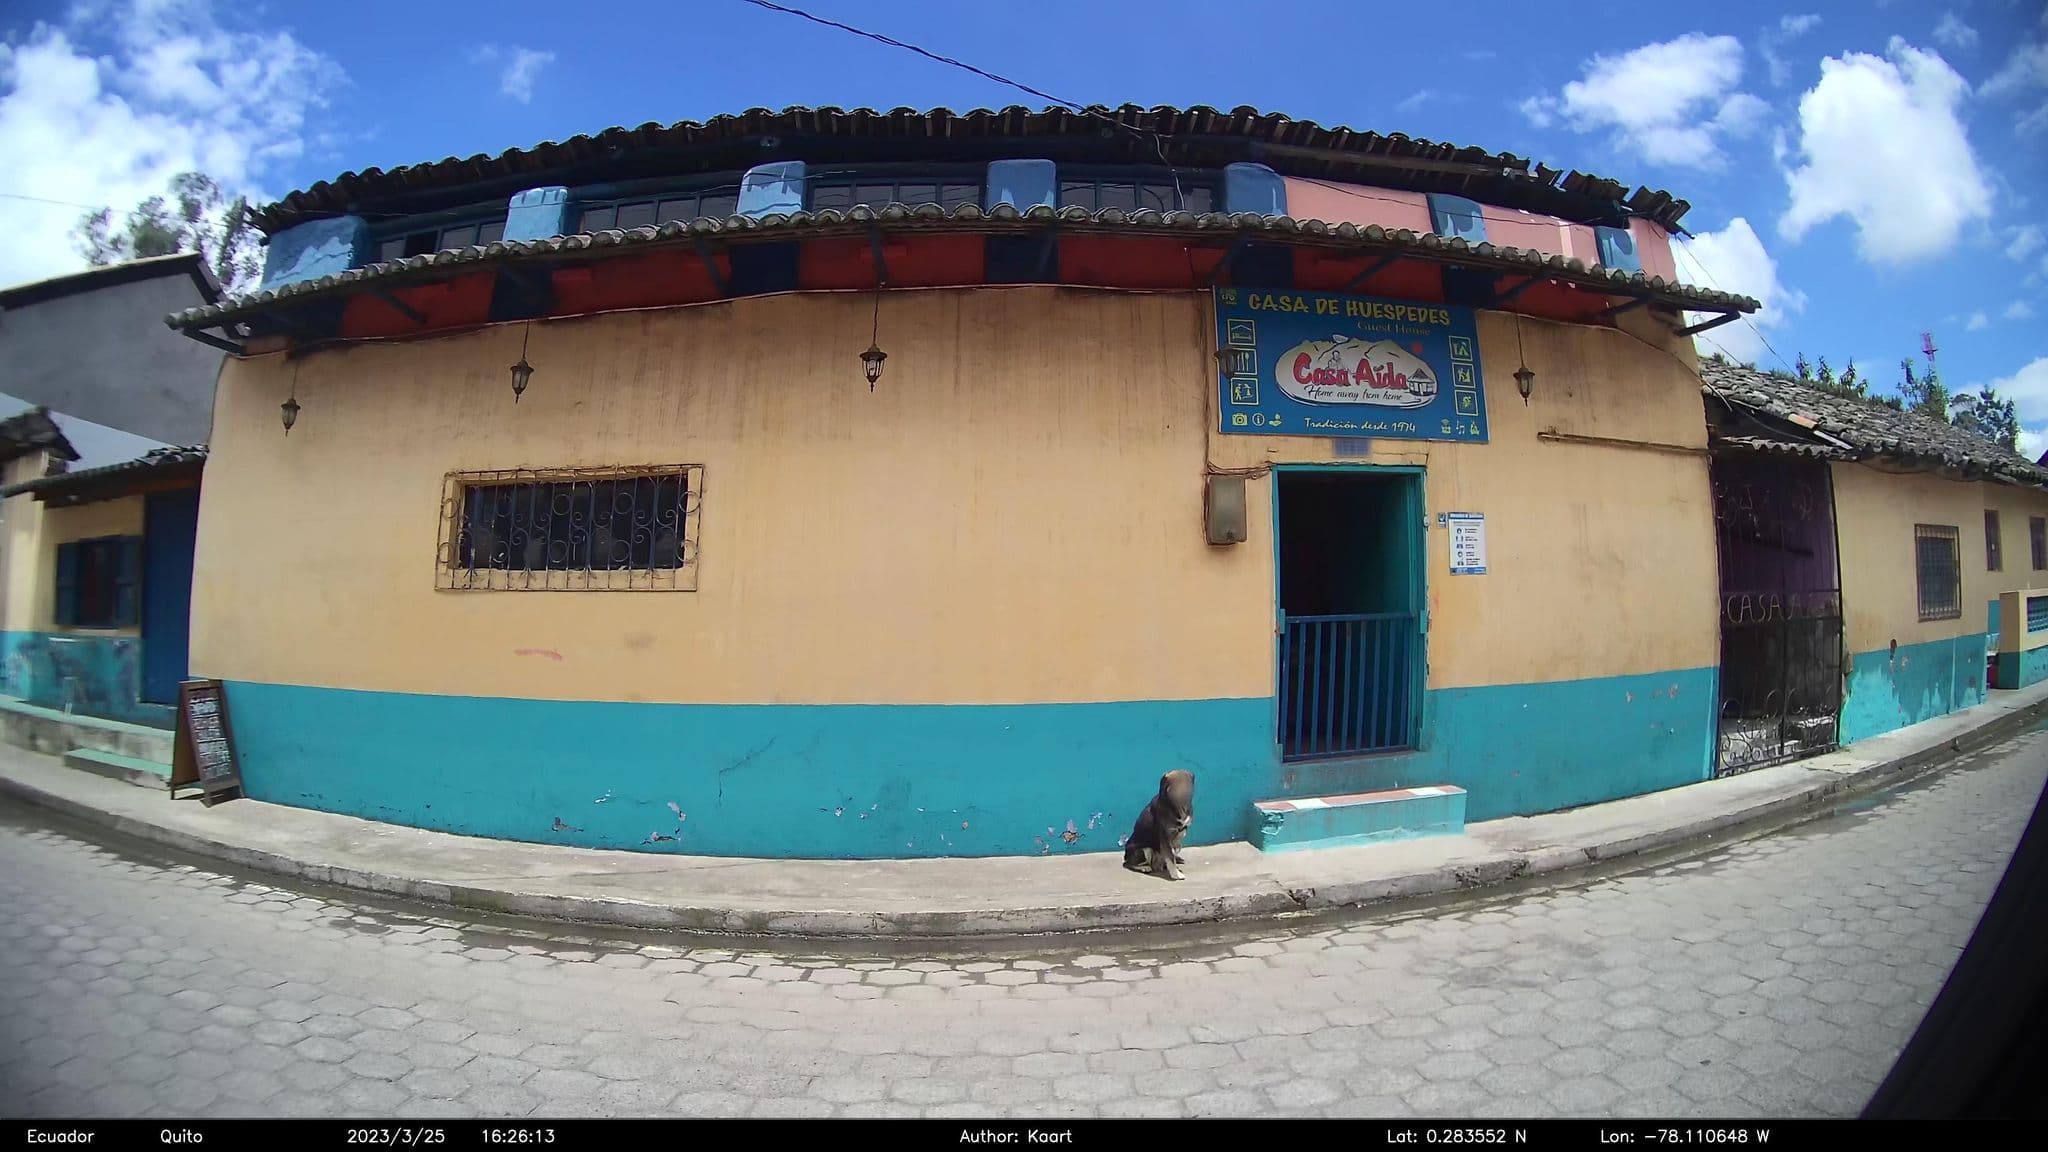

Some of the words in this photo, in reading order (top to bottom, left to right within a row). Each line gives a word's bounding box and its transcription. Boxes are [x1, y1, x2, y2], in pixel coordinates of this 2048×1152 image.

[1248, 293, 1309, 313] CASA
[1315, 298, 1339, 315] DE
[1346, 300, 1450, 326] HUESPEDES
[1357, 320, 1392, 333] Guest
[1395, 323, 1432, 337] House
[1293, 352, 1351, 387] Casa
[1304, 385, 1333, 399] Home
[1336, 391, 1358, 401] away
[1304, 417, 1358, 430] Tradición
[1361, 421, 1388, 431] desde
[1391, 421, 1416, 433] 1974
[1727, 593, 1785, 625] CASA
